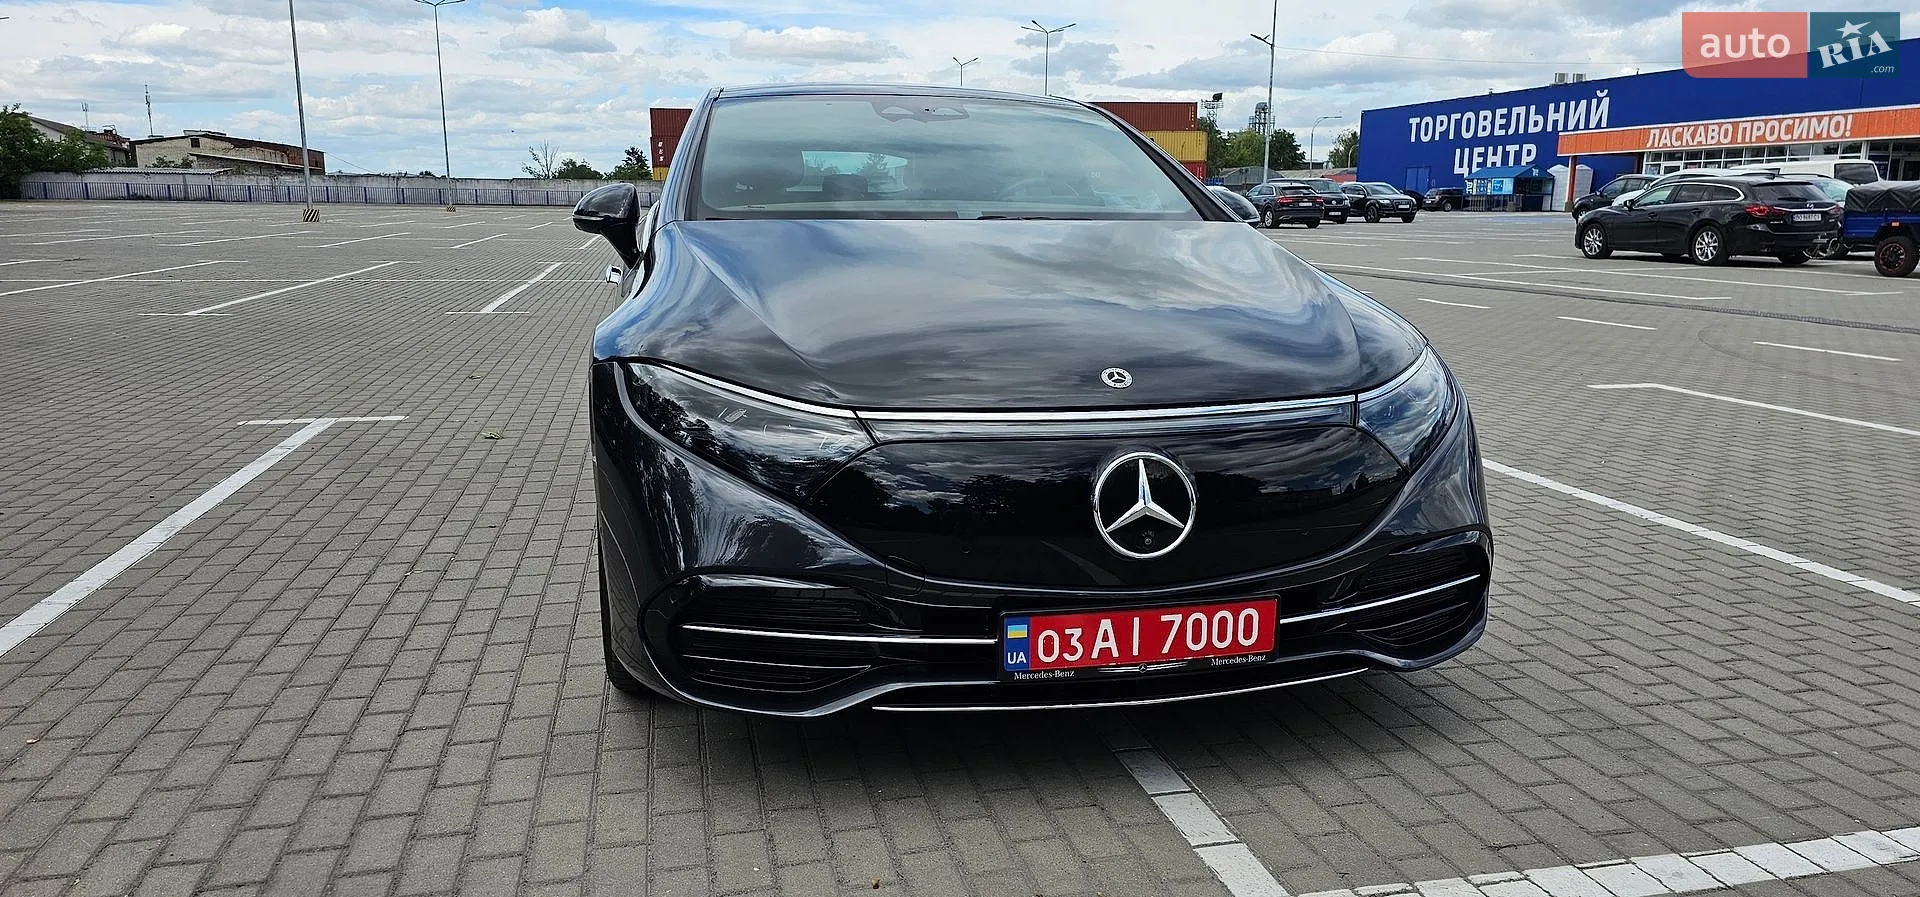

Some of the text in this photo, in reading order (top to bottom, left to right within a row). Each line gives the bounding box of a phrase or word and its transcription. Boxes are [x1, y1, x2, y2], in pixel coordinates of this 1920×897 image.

[1408, 89, 1610, 143] ТОРГОВЕЛЬНИЙ
[1646, 114, 1854, 148] ЛАСКАВО ПРОСИМО!
[1453, 143, 1537, 178] ЦЕНТР
[1160, 608, 1259, 654] 7000
[1007, 652, 1027, 664] UA
[1013, 669, 1075, 680] Mercedes-Benz
[1211, 653, 1266, 666] Mercedes-Benz
